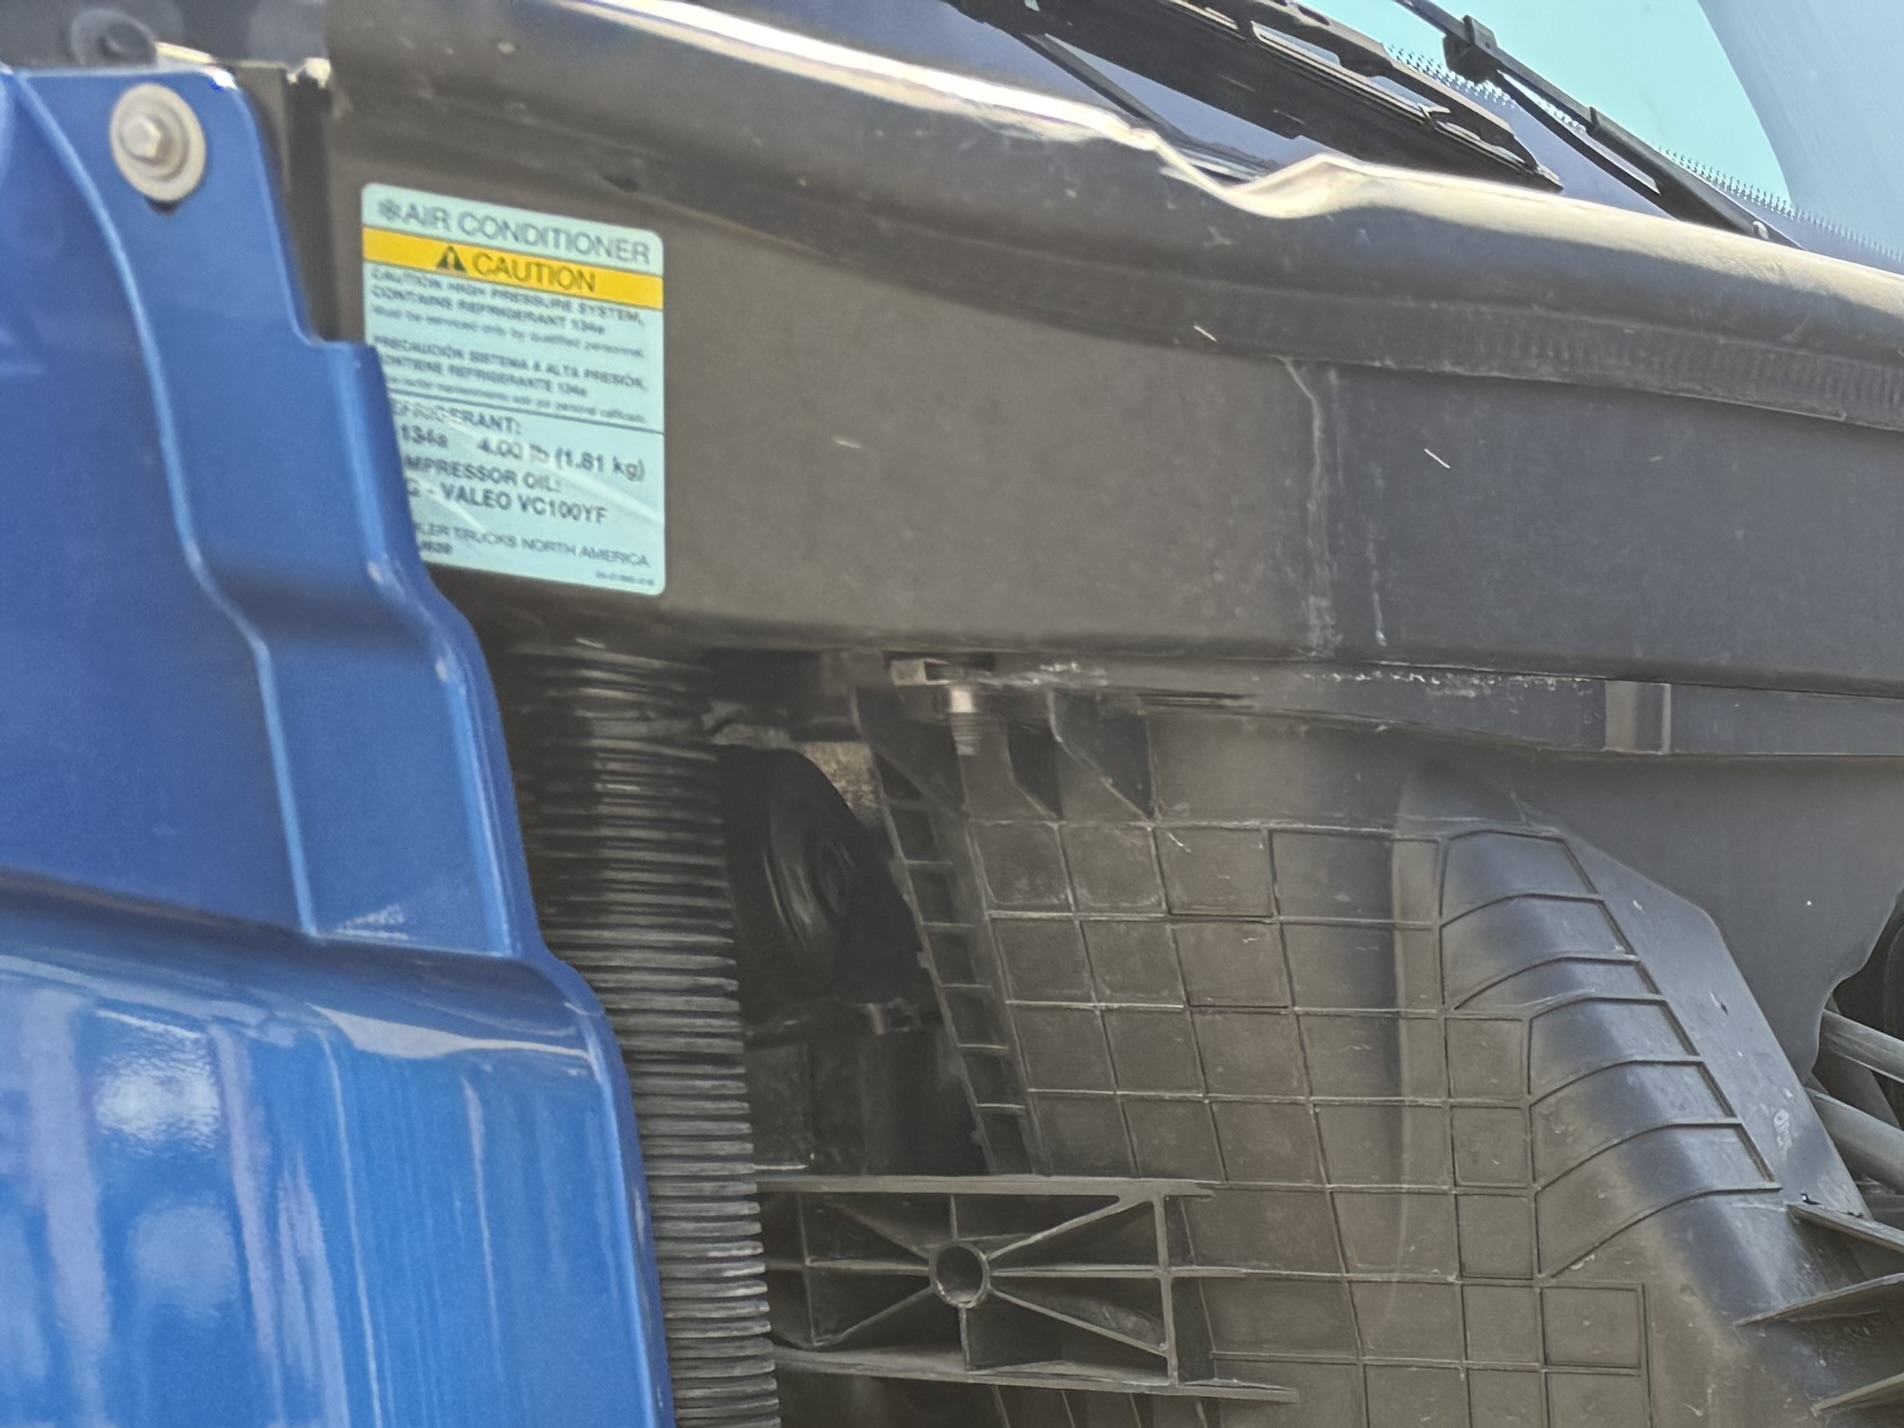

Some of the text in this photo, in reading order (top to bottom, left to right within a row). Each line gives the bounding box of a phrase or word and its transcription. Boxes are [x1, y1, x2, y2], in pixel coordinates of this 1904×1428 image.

[402, 203, 650, 265] AIR CONDITIONER
[371, 267, 442, 291] CAUTION
[492, 286, 572, 315] PRESSURE
[471, 252, 596, 293] CAUTION
[372, 287, 451, 309] CONTAINS
[456, 300, 566, 330] REFRIGERANT
[405, 454, 561, 494] MPRESSOR OIL:
[478, 438, 523, 460] 4.00
[554, 447, 605, 473] (1.81
[612, 457, 645, 482] kg)
[440, 482, 512, 511] VALEO
[517, 495, 608, 523] VC100YF
[521, 533, 577, 557] NORTH
[579, 542, 650, 567] AMERICA
